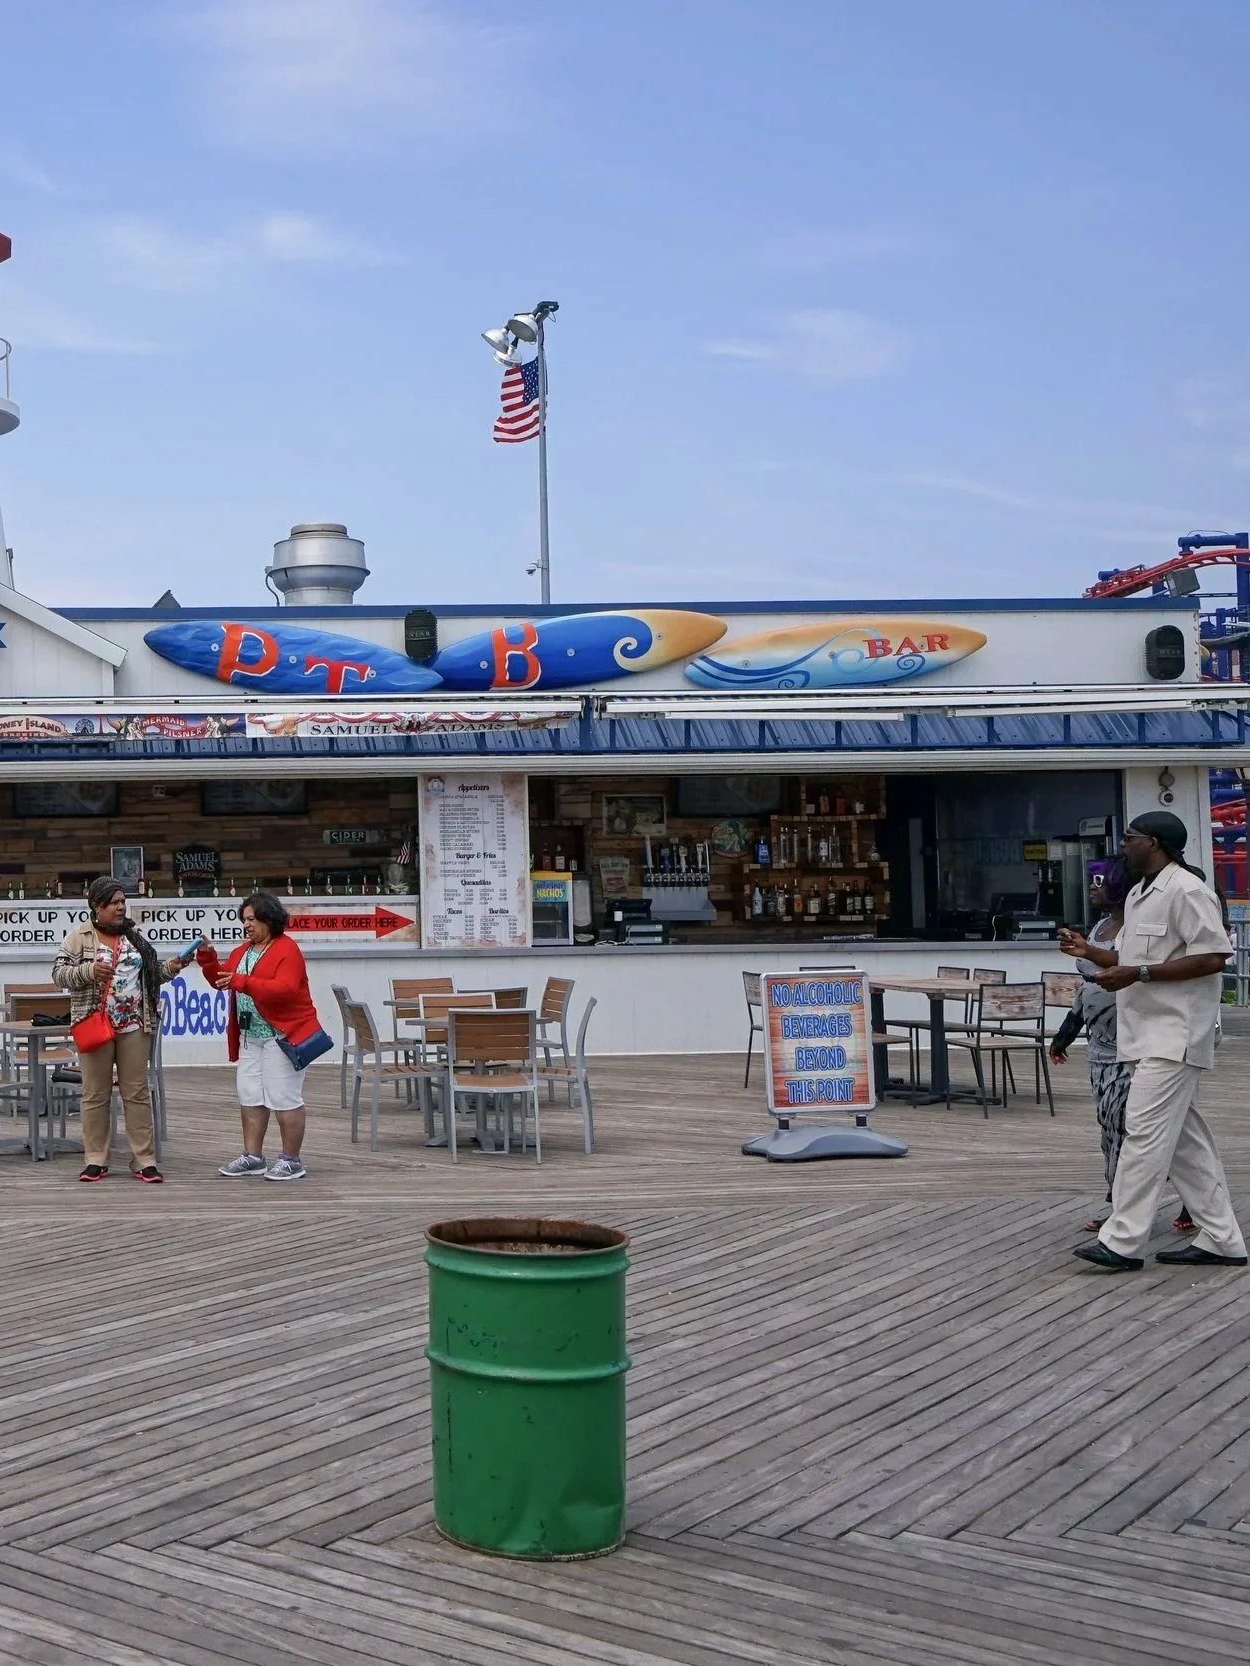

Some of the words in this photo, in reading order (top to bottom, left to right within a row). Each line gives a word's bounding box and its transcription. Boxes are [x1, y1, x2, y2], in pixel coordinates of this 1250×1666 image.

[862, 633, 950, 659] BAR
[25, 718, 61, 733] ISLAND
[142, 716, 185, 726] MERMAID
[163, 728, 202, 738] PILSNER
[310, 724, 392, 735] SAMUEL
[434, 723, 505, 733] ADAMS
[331, 831, 365, 839] CIDER
[175, 851, 219, 864] SAMUEL
[455, 852, 476, 860] Burger
[179, 861, 215, 872] ADAMS
[536, 888, 564, 898] NACHOS
[38, 911, 58, 923] UP
[67, 911, 90, 923] YO
[141, 910, 177, 922] PICK
[185, 909, 206, 921] UP
[214, 909, 237, 921] YO
[287, 918, 310, 929] LACE
[314, 918, 338, 929] YOUR
[341, 917, 371, 928] ORDER
[374, 917, 398, 928] HERE
[0, 930, 55, 942] ORDER
[147, 928, 202, 940] ORDER
[771, 983, 791, 1007] NO
[791, 981, 862, 1007] ALCOHOLIC
[160, 977, 230, 1036] oBeac
[781, 1013, 853, 1039] BEVERAGES
[795, 1046, 846, 1071] BEYOND
[785, 1079, 814, 1103] THIS
[815, 1077, 855, 1103] POINT
